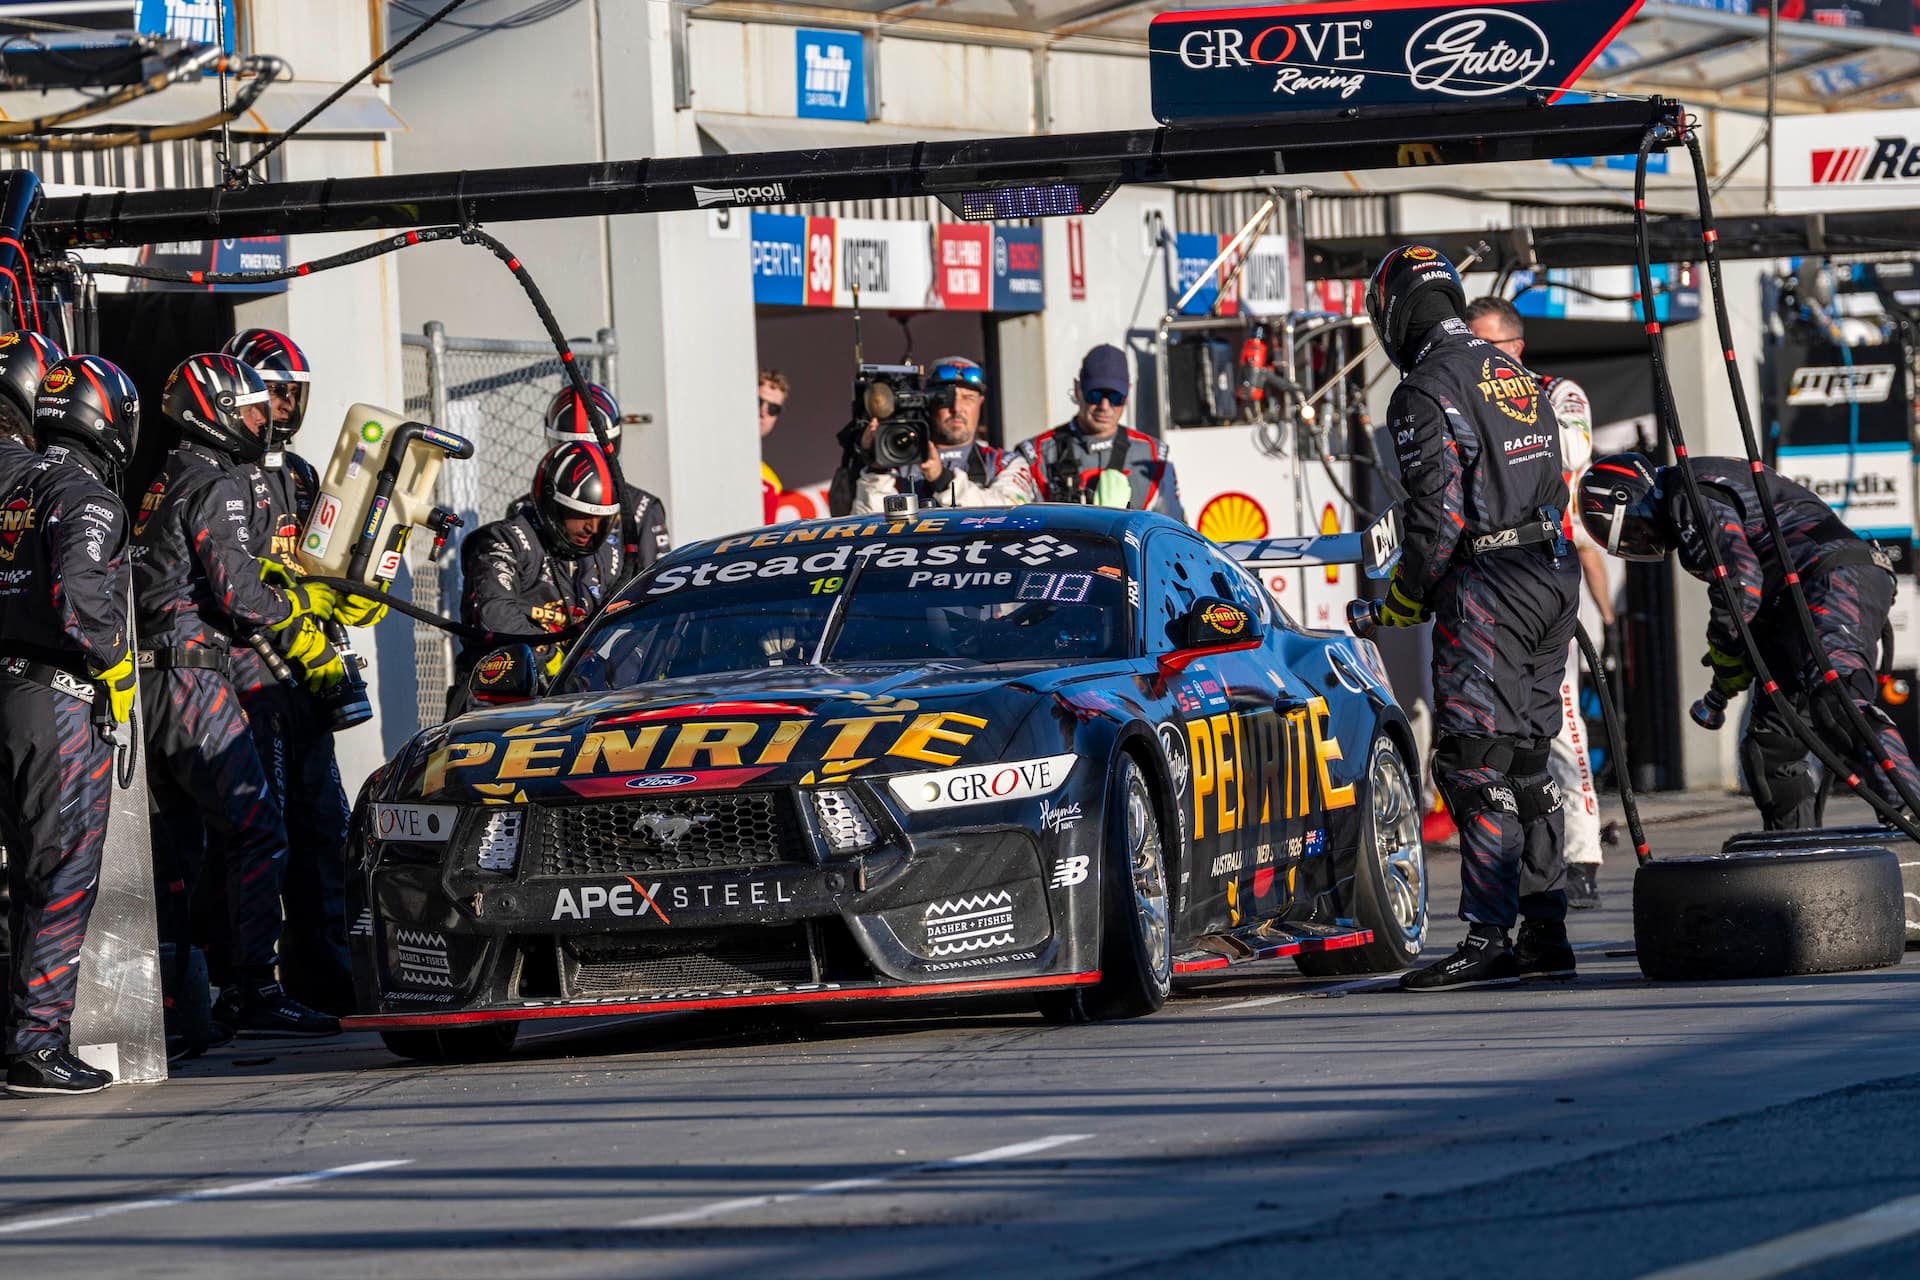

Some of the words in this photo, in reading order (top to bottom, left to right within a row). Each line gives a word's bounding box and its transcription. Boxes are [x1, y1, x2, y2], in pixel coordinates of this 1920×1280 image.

[1411, 19, 1535, 92] Gates
[1273, 68, 1366, 99] Racing
[733, 182, 786, 203] paoli
[752, 240, 803, 277] PERTH
[810, 233, 833, 293] 38
[1421, 270, 1452, 282] MAGIC
[36, 407, 66, 419] SHIPPY
[84, 503, 114, 519] FORD
[713, 518, 950, 555] PENRITE
[646, 540, 992, 595] Steadfast
[809, 577, 844, 595] 19
[908, 570, 1013, 590] Payne
[1128, 576, 1140, 609] HRX
[1201, 611, 1249, 625] PENRITE
[477, 659, 516, 673] PENRITE
[1562, 684, 1592, 792] SUPERCARS
[421, 712, 988, 797] PENRITE
[1186, 696, 1356, 841] PENRITE
[640, 775, 682, 787] Ford
[948, 762, 1052, 802] GROVE
[1040, 799, 1083, 834] Haymes
[1287, 836, 1303, 858] 1926
[551, 875, 671, 925] APEX
[673, 881, 792, 909] STEEL
[927, 921, 968, 937] DASHER
[978, 913, 1013, 928] FISHER
[398, 951, 421, 964] DASHER
[426, 954, 448, 967] FISHER
[923, 955, 1010, 973] TASMANIAN
[1011, 951, 1036, 961] GIN
[1446, 959, 1468, 971] HRX
[385, 991, 435, 1002] TASMANIAN
[435, 994, 454, 1003] GIN
[54, 1065, 72, 1079] HRX
